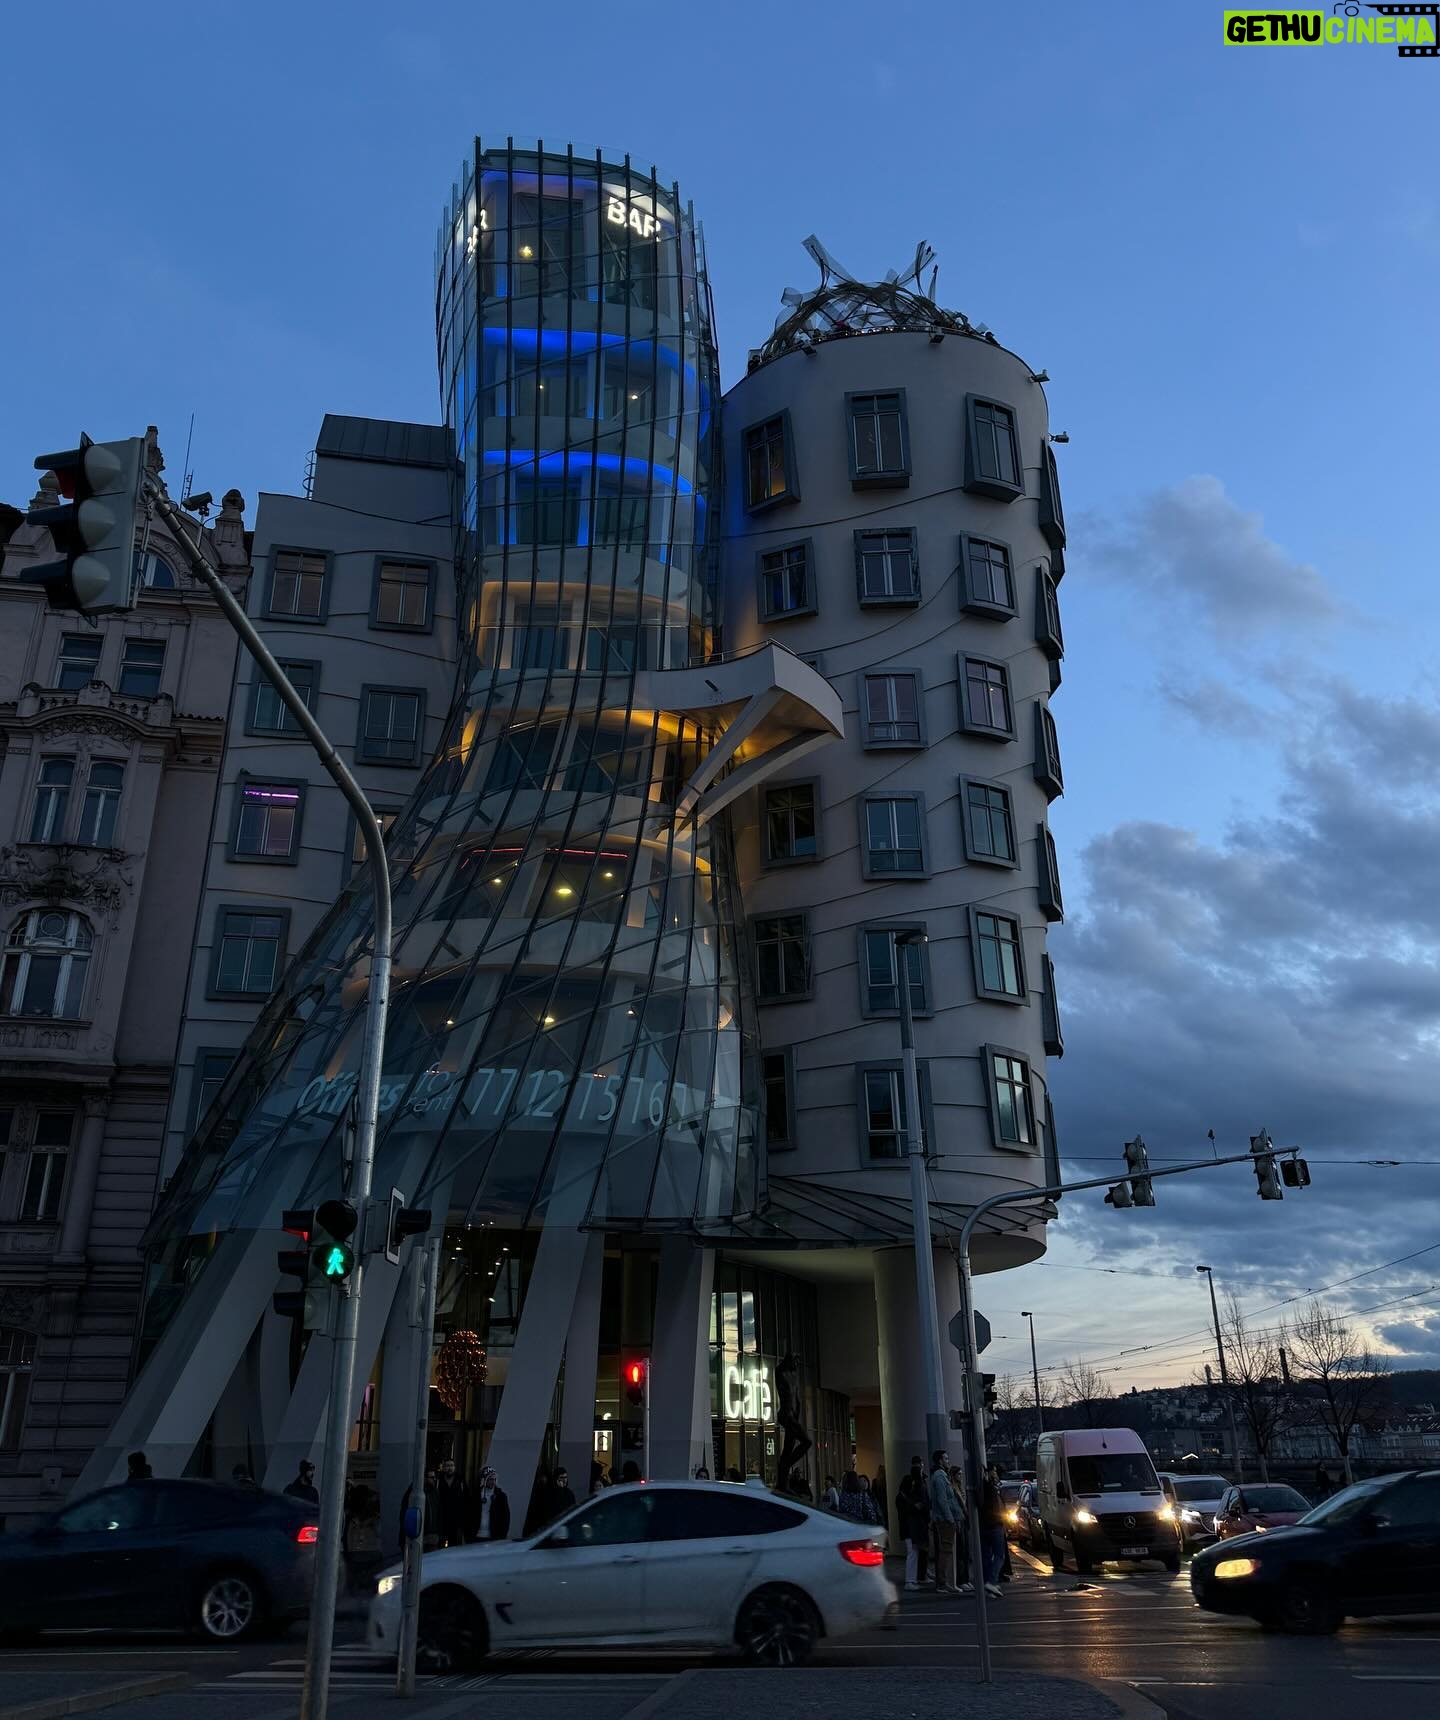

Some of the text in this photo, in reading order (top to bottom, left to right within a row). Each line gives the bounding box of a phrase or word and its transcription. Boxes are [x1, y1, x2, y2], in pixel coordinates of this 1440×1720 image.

[607, 196, 662, 243] BAR
[296, 1071, 408, 1114] Offies
[725, 1365, 772, 1421] Café
